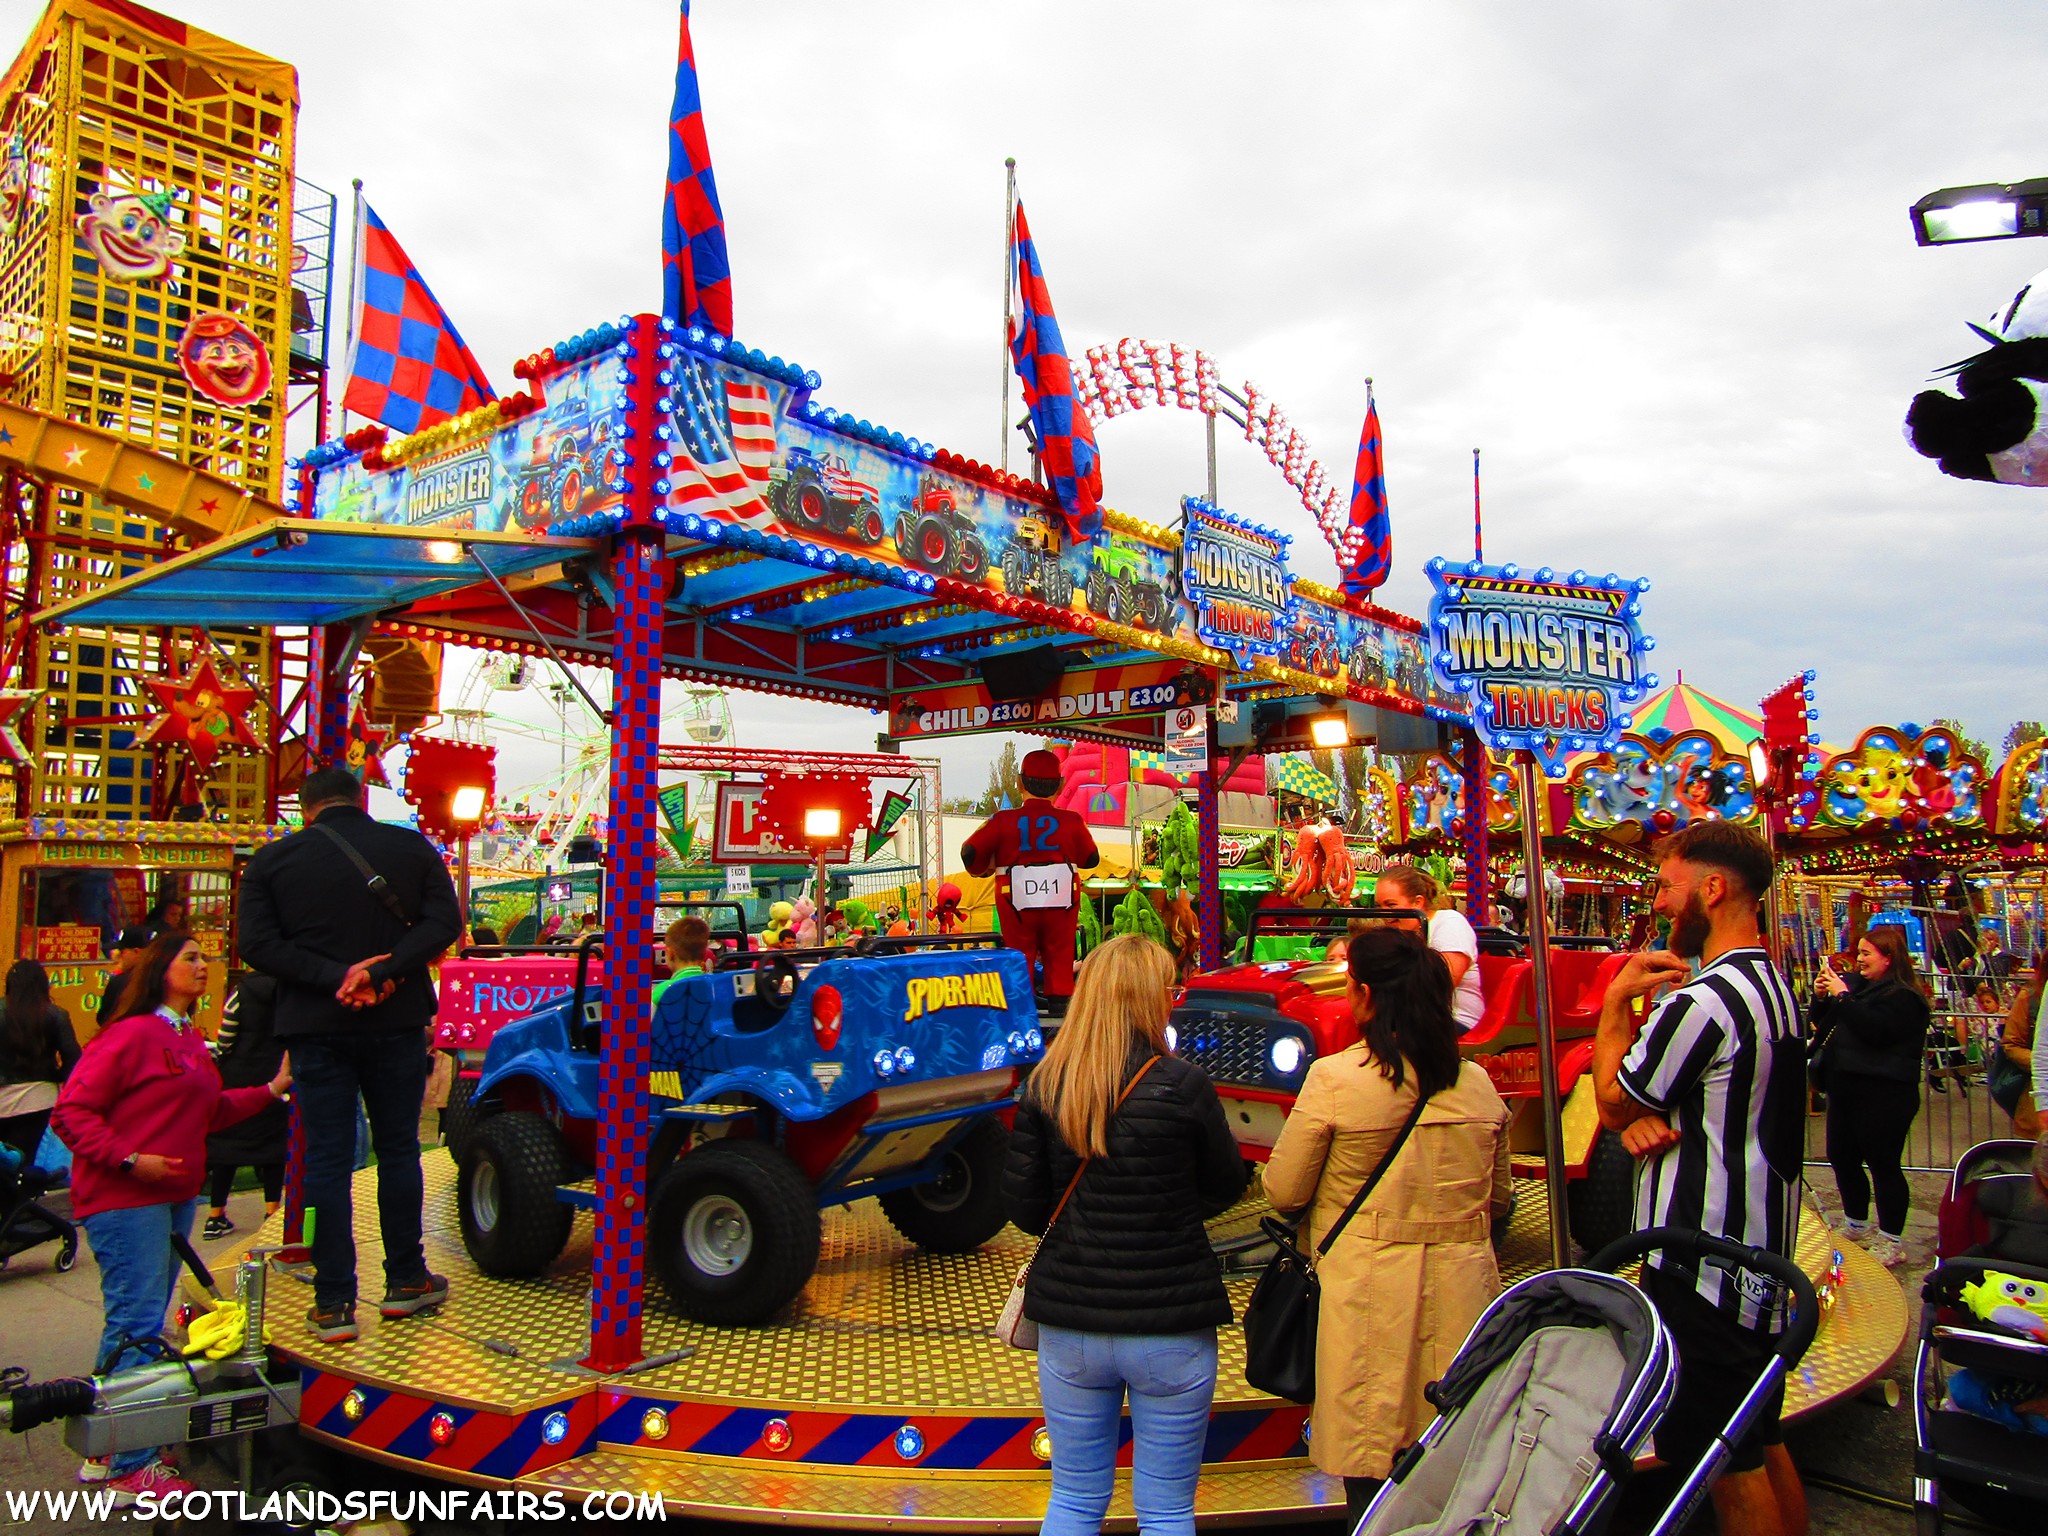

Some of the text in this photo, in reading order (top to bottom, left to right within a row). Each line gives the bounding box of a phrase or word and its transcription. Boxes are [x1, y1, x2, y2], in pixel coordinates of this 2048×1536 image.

[1070, 337, 1223, 430] ONSTER
[408, 458, 490, 524] MONSTER
[1190, 538, 1286, 609] MONSTER
[1206, 597, 1273, 640] TRUCKS
[1449, 611, 1633, 684] MONSTER
[919, 684, 1175, 732] CHILD £3.00 ADULT £3.00
[1487, 684, 1606, 731] TRUCKS
[660, 787, 685, 831] ACTION
[880, 796, 909, 835] ACTION
[43, 845, 227, 864] HELTER SKELTER
[1017, 815, 1060, 851] 12
[1025, 879, 1059, 895] D41
[60, 929, 93, 937] CHILDREN
[60, 944, 72, 952] THE
[74, 944, 88, 952] TOP
[48, 967, 84, 988] ALL
[474, 983, 575, 1014] FROZ
[905, 972, 1007, 1022] SPIDER-MAN
